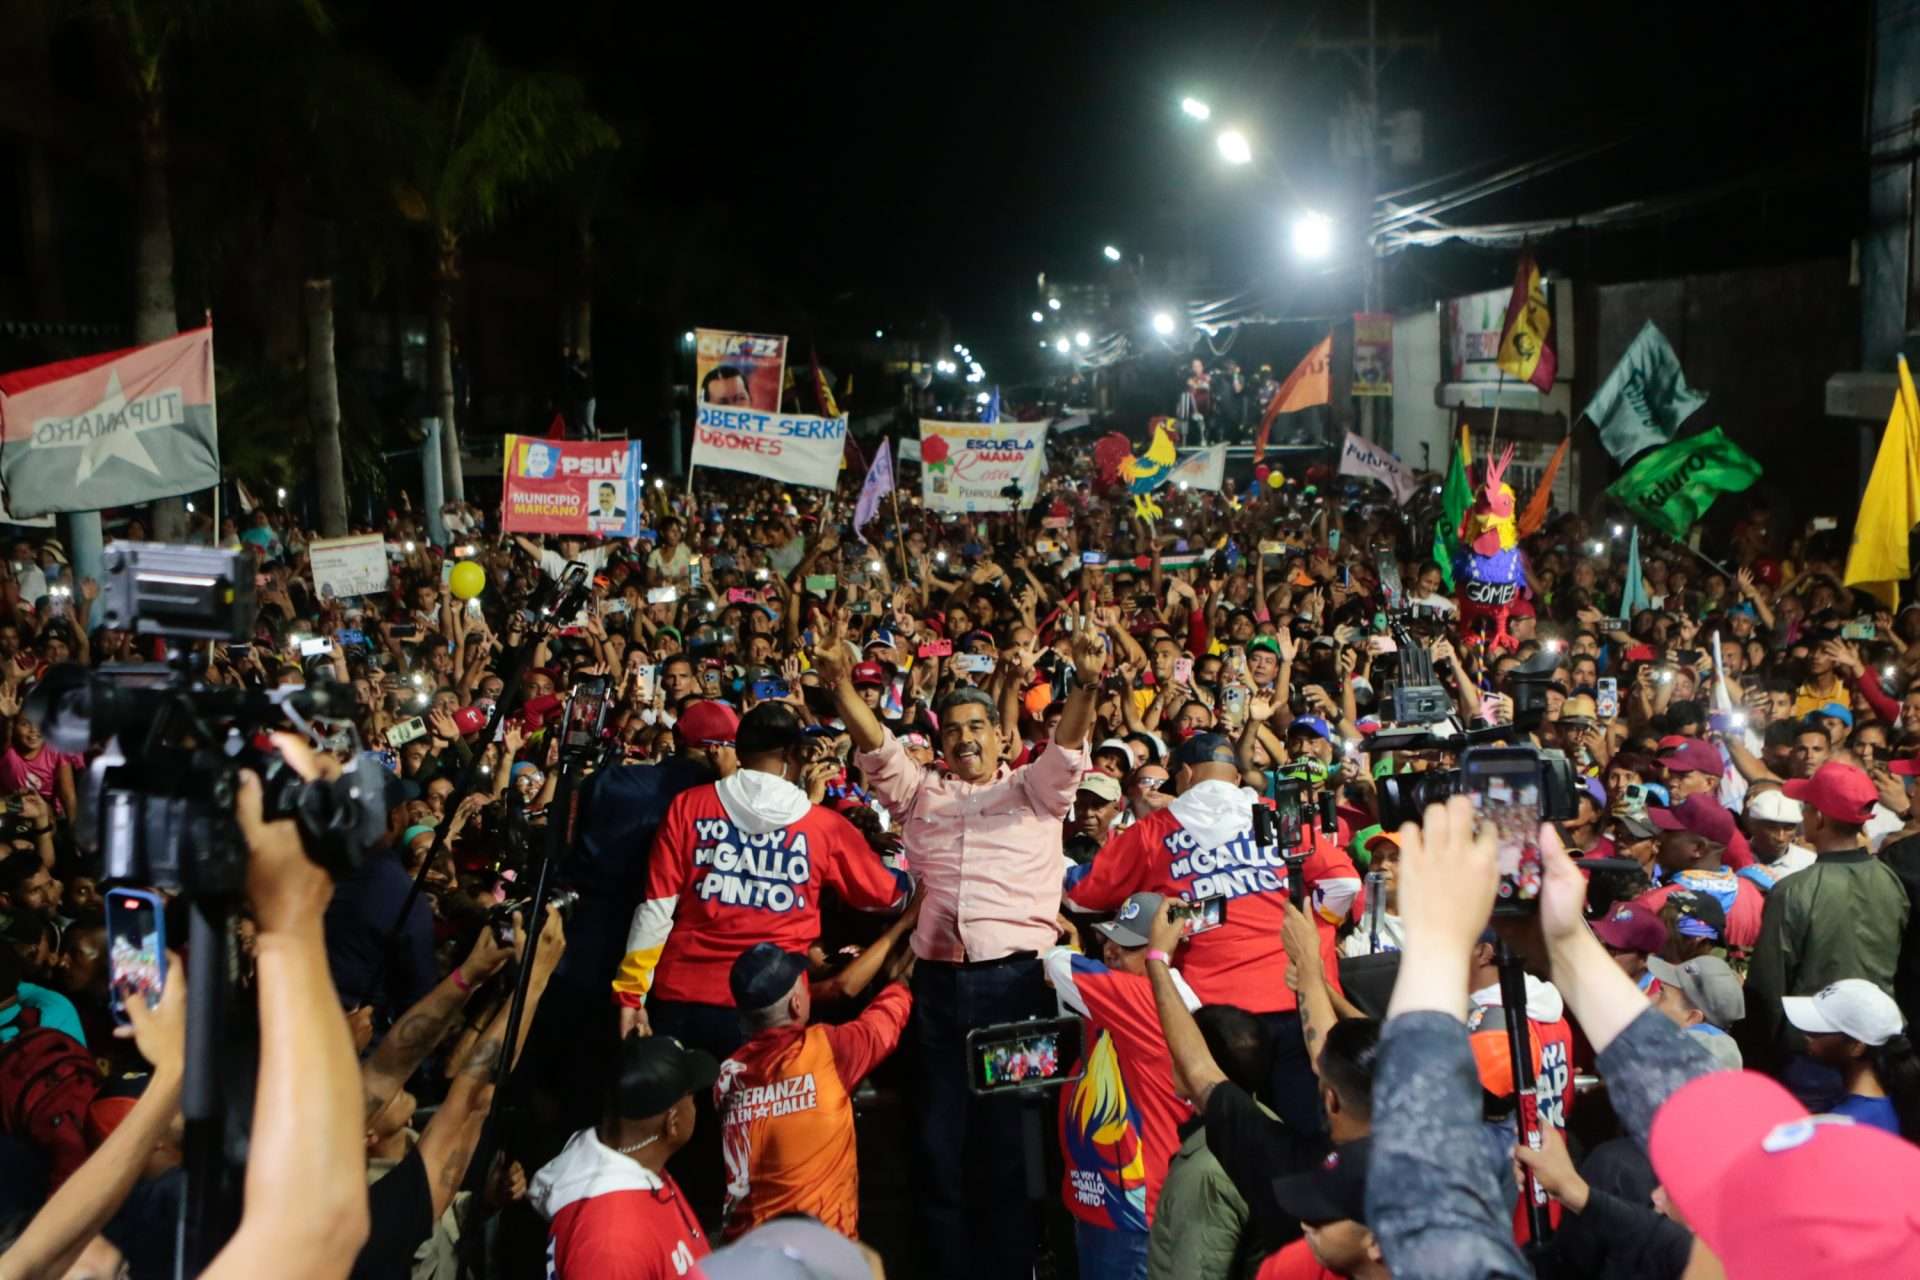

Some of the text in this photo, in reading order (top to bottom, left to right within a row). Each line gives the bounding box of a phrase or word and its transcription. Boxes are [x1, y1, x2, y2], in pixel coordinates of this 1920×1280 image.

[966, 439, 1034, 450] ESCUELA
[561, 450, 628, 476] PSUV
[512, 493, 581, 506] MUNICIPIO
[515, 504, 579, 517] MARCANO
[696, 819, 729, 841] YO
[790, 833, 808, 856] A
[713, 842, 809, 884] GALLO
[772, 1092, 817, 1117] CALLE
